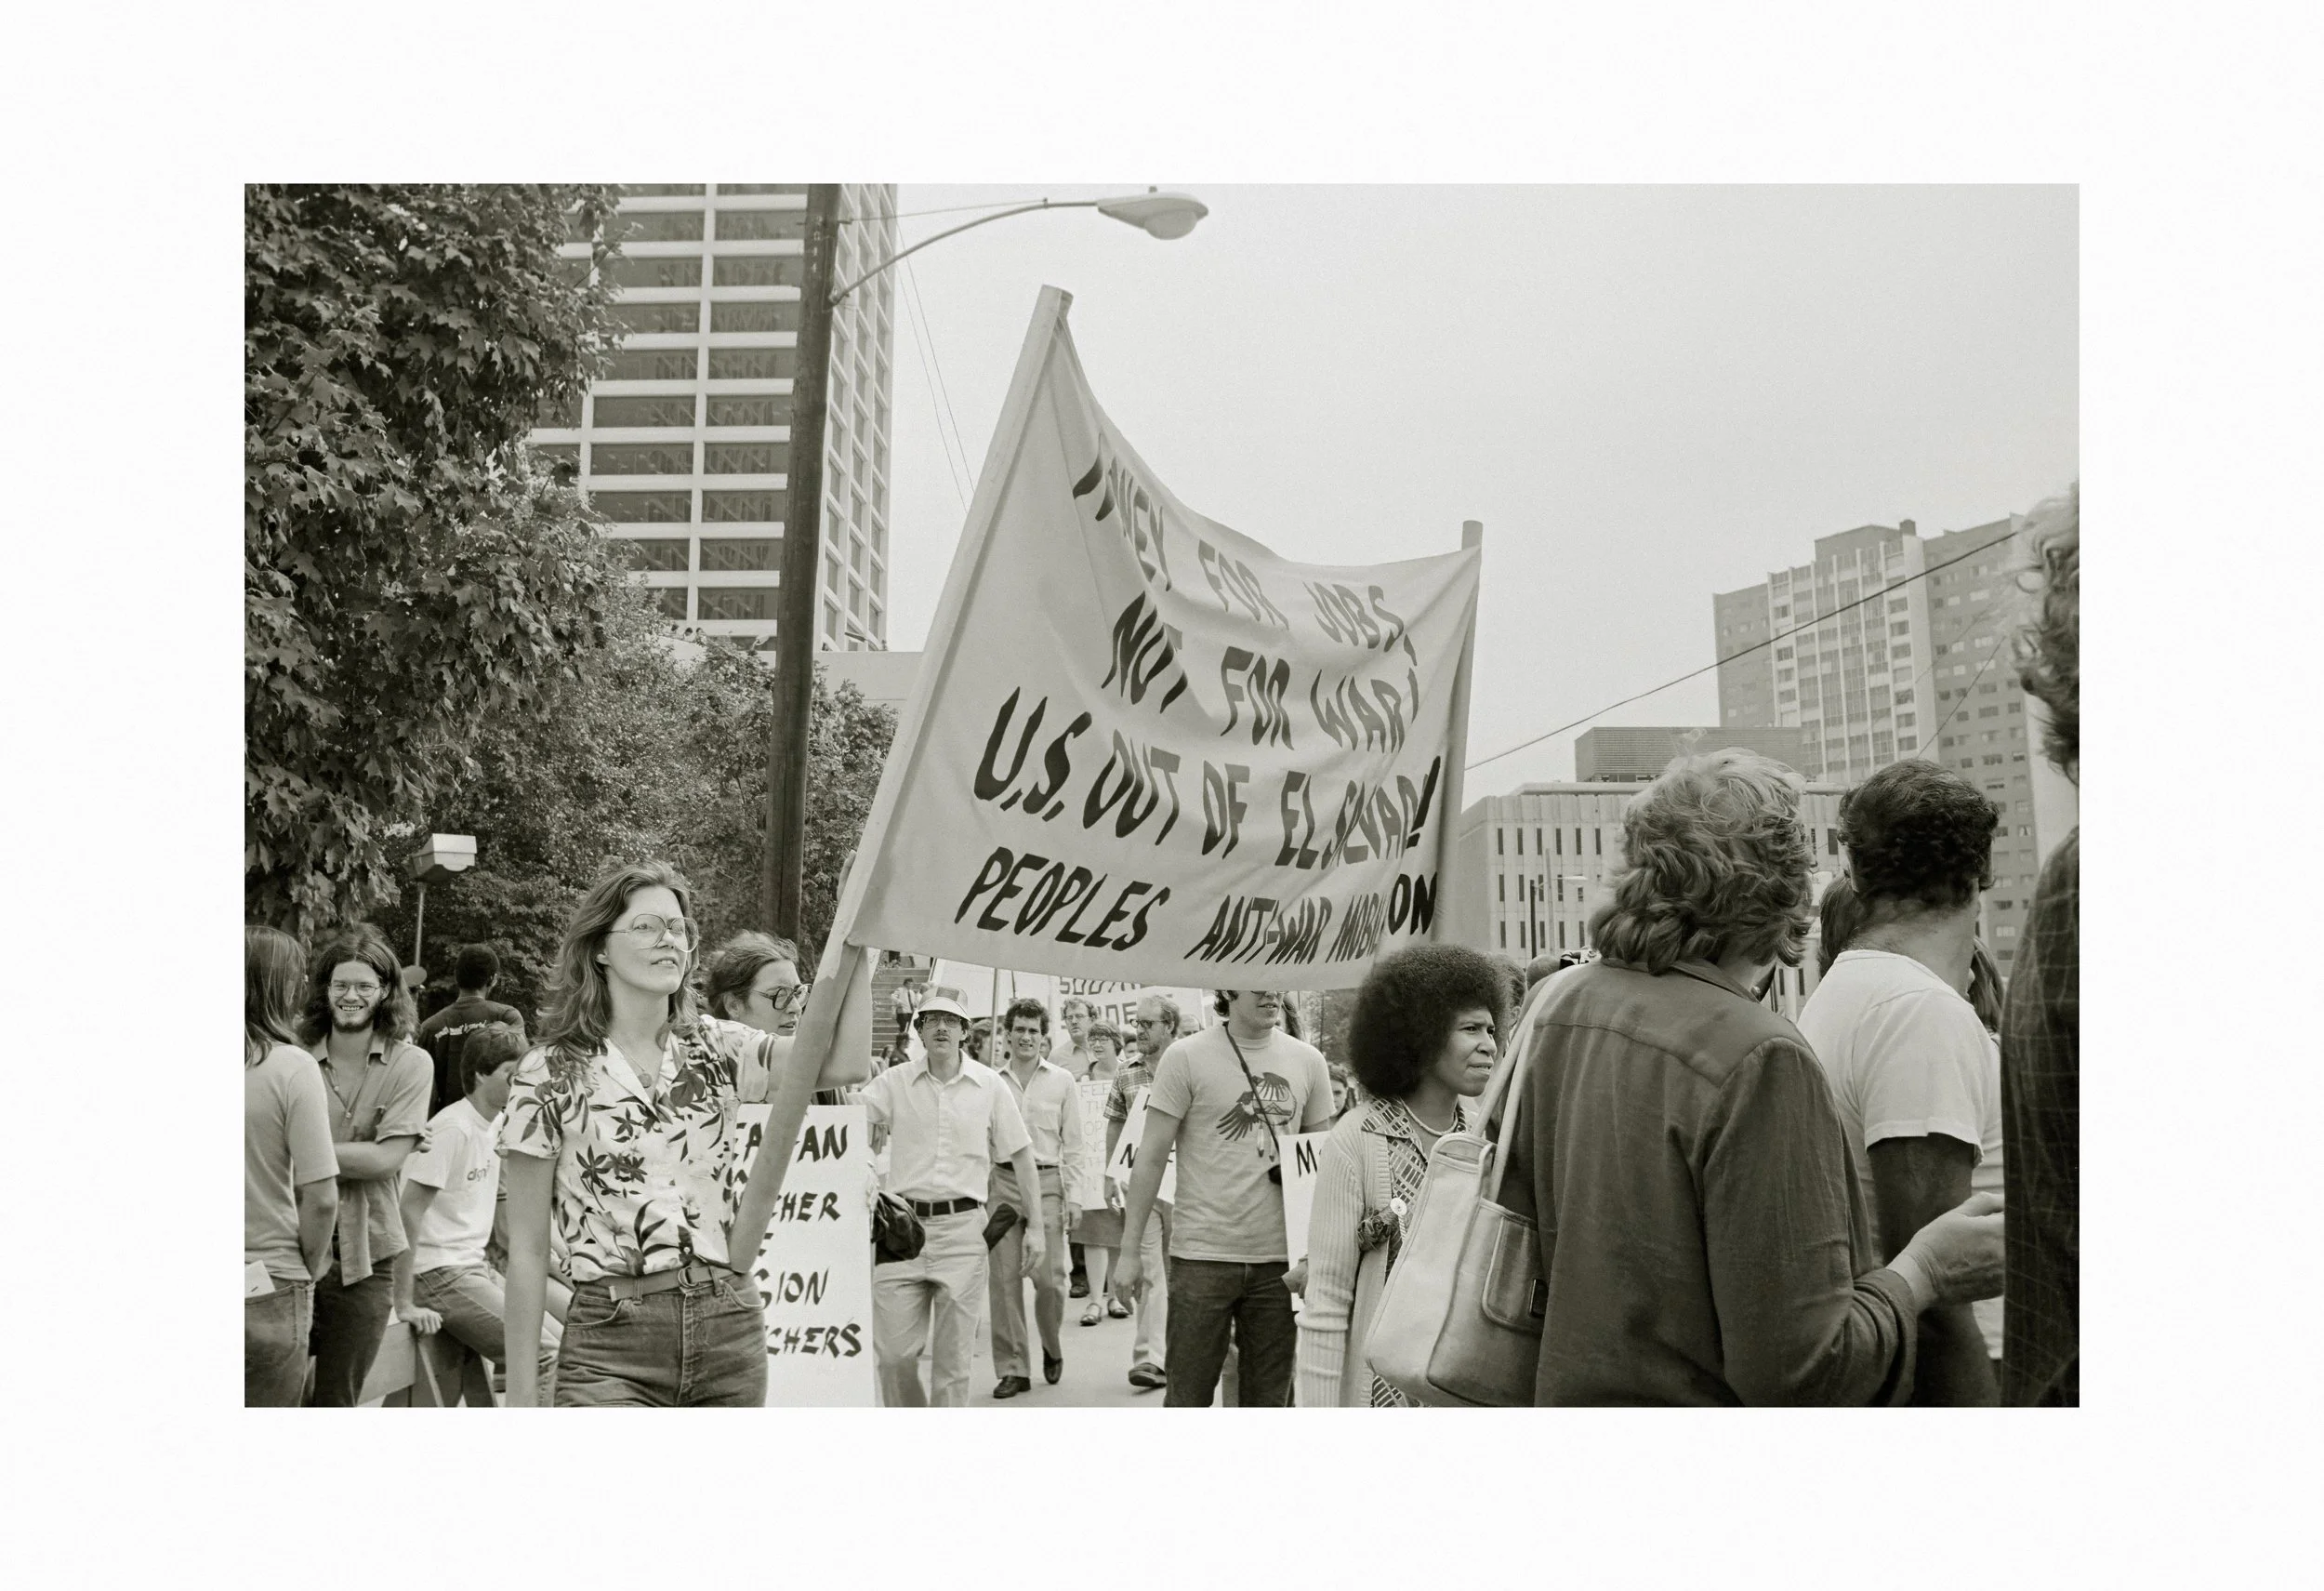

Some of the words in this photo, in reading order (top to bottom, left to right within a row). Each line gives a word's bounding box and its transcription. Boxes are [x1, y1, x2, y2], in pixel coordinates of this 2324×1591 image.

[1197, 538, 1291, 631] FOR
[1101, 590, 1189, 715] NOT
[1216, 644, 1295, 751] FOR
[973, 685, 1093, 823] U.S.
[1083, 729, 1182, 847] OUT
[1201, 760, 1250, 860] OF
[1274, 770, 1320, 870] EL
[954, 846, 1171, 952] PEOPLES
[1183, 895, 1333, 965] ANTI-WAR
[766, 1323, 862, 1359] CHERS
